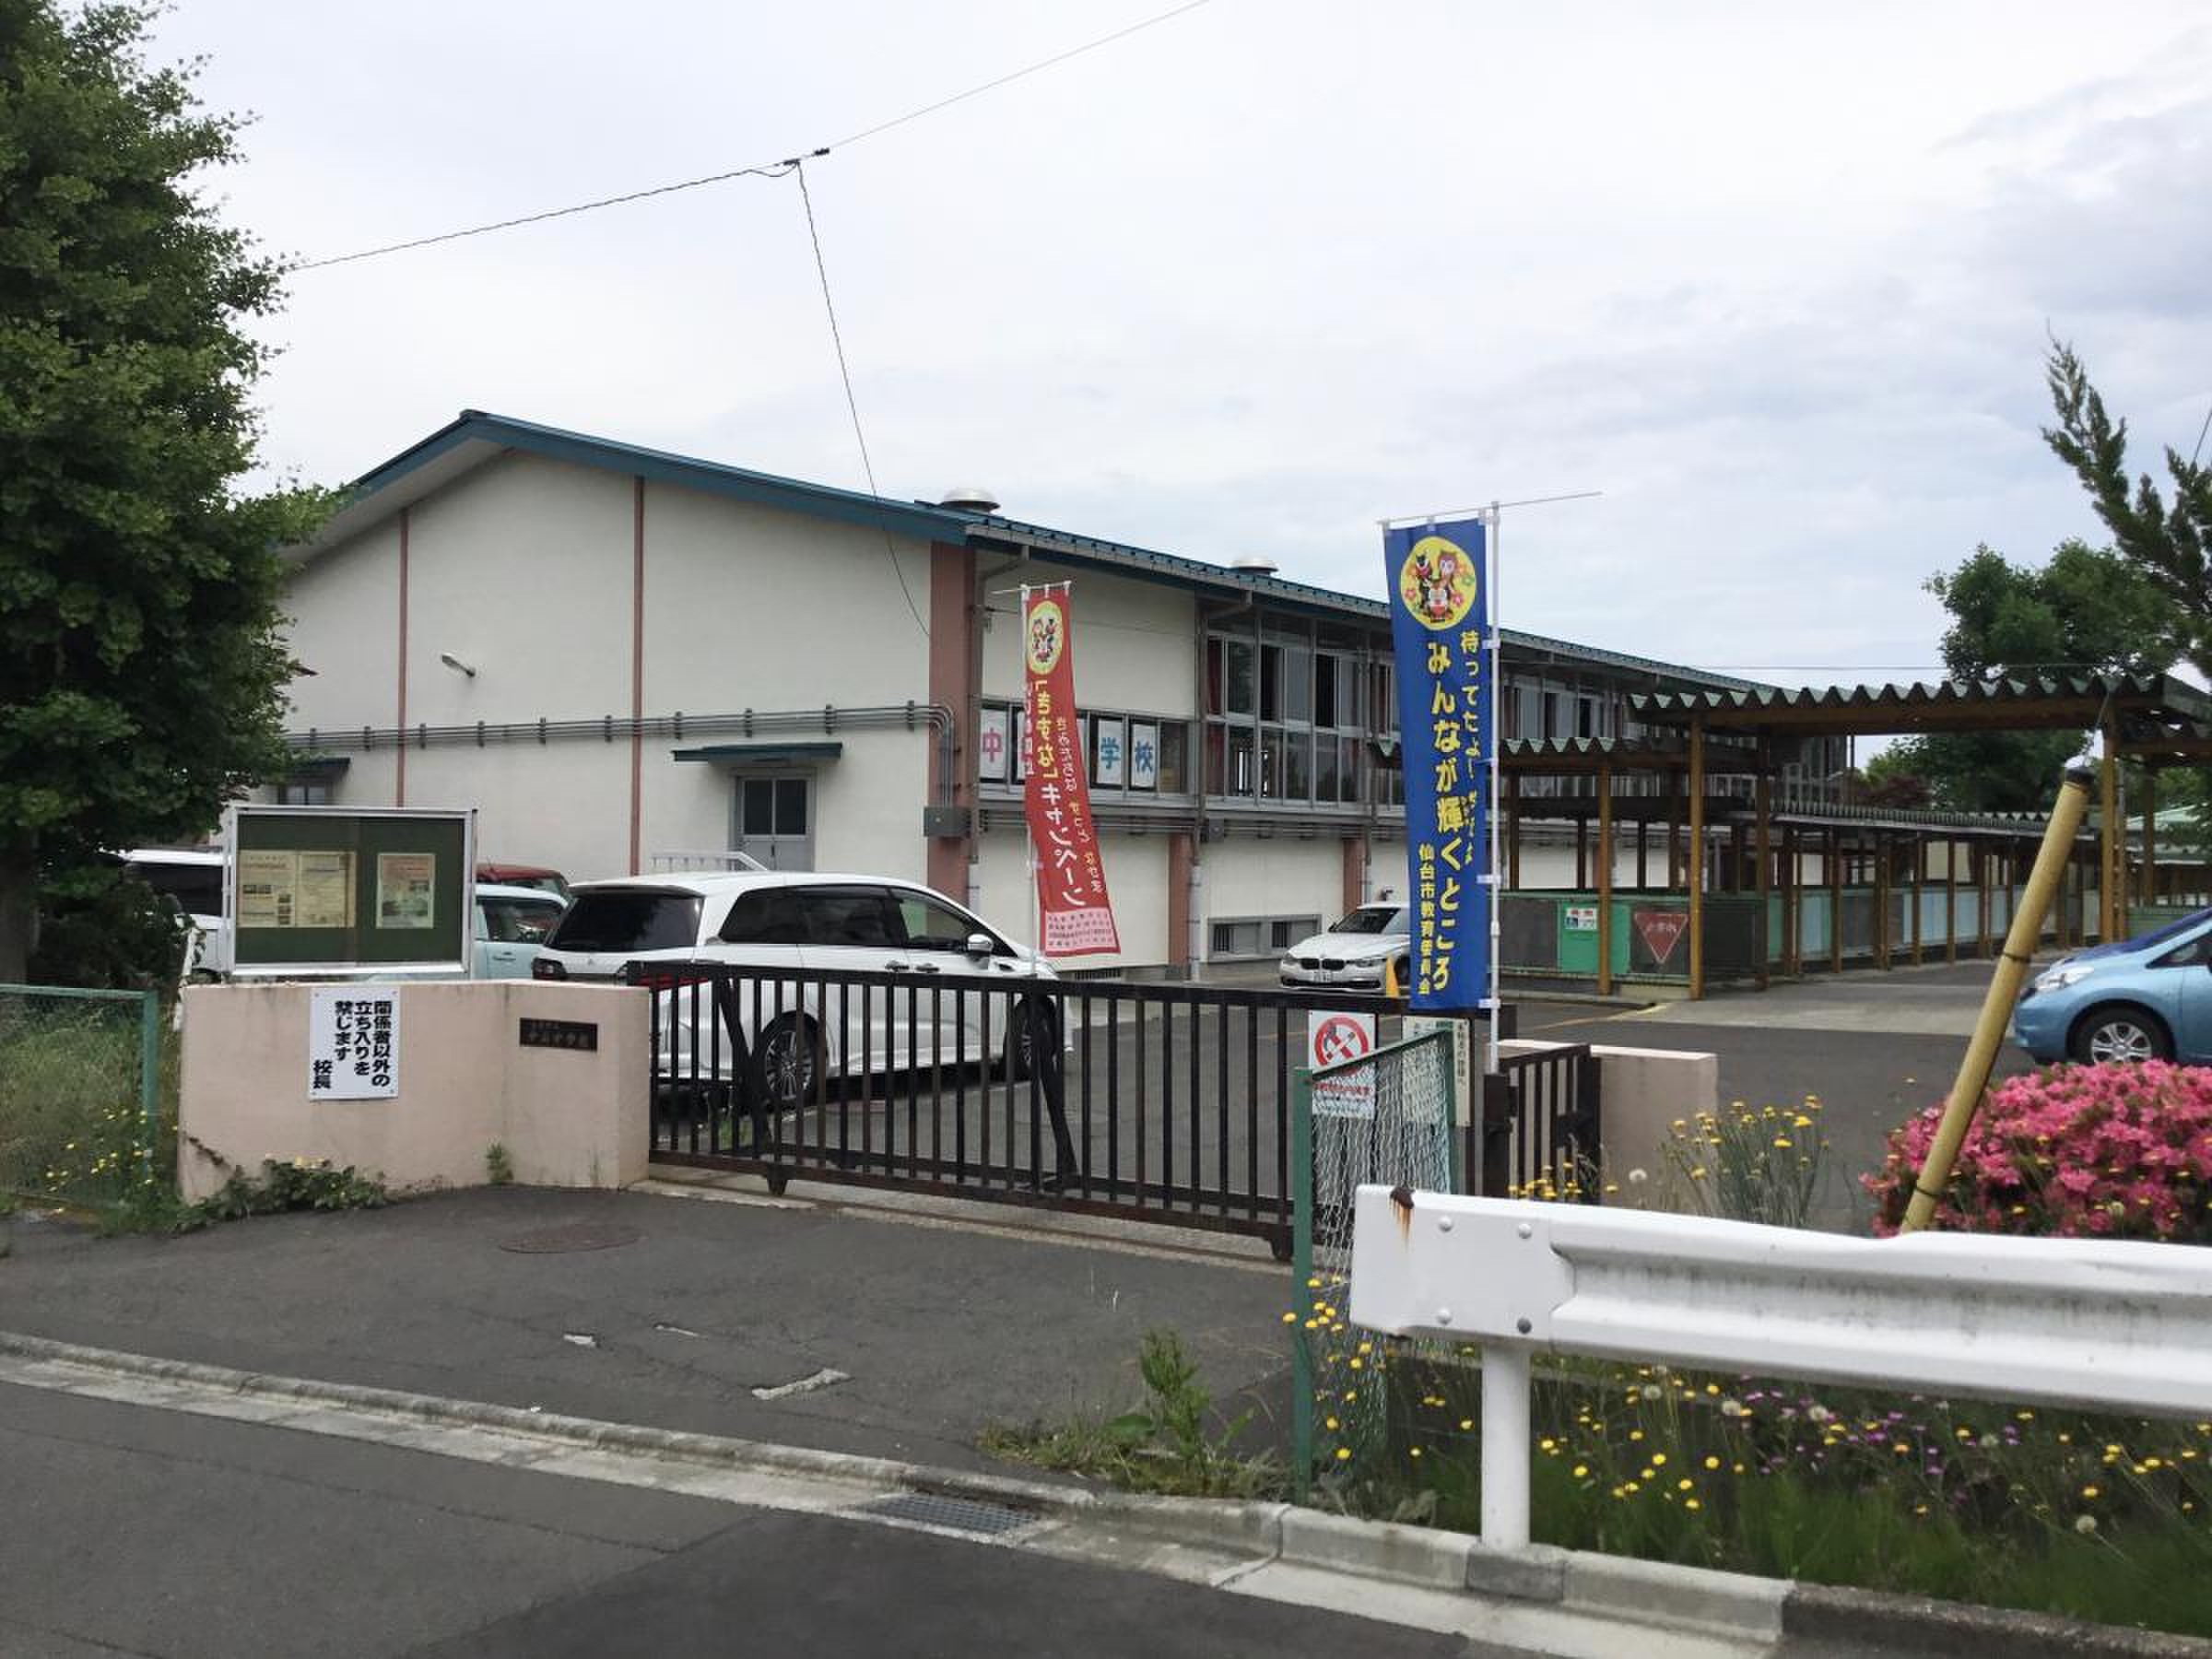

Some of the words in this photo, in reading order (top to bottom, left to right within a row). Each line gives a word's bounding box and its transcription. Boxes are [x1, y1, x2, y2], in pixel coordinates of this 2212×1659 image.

[1428, 641, 1462, 991] みんなが輝くところ
[1417, 842, 1435, 995] 仙台市教育委員会
[334, 1000, 353, 1062] 禁じます
[354, 1000, 372, 1077] 立ち入りを
[371, 1000, 393, 1088] 関係者以外の
[312, 1059, 333, 1089] 校長
